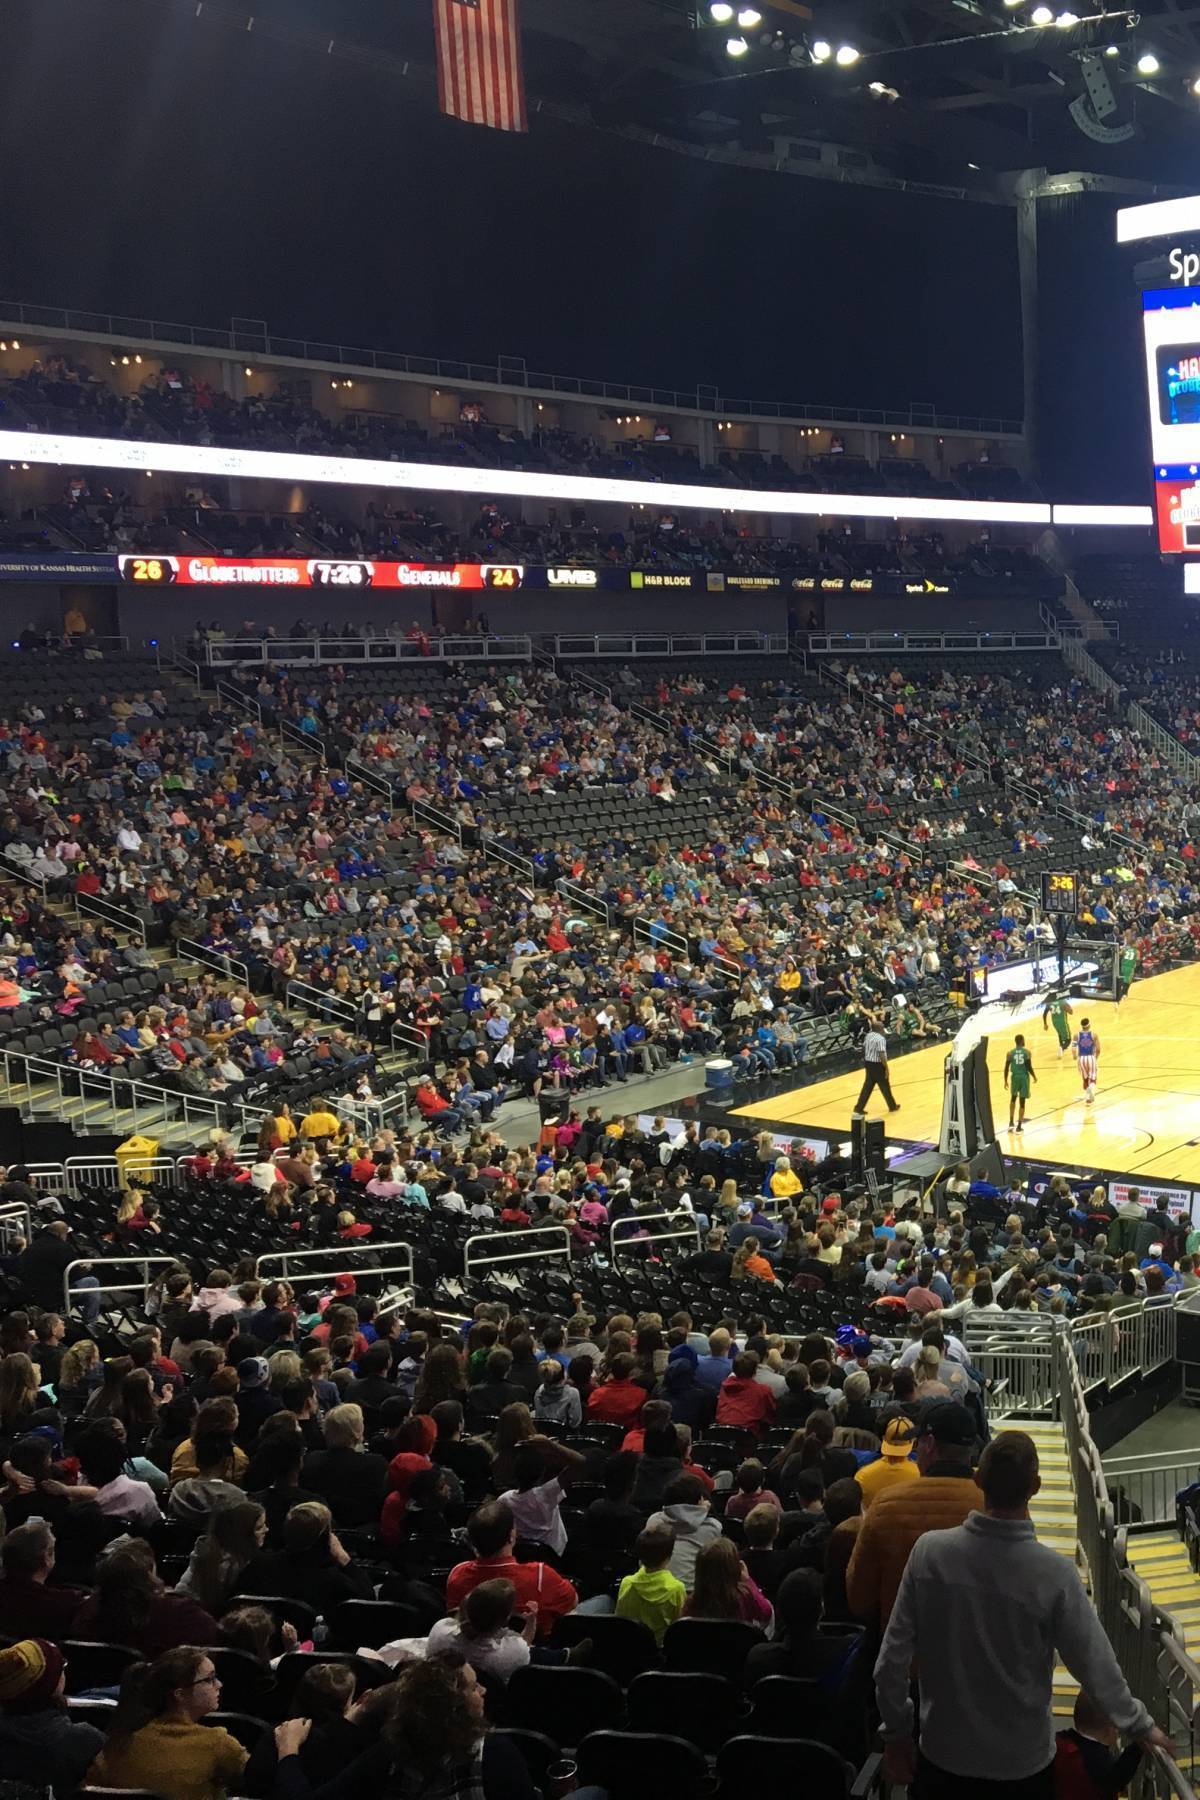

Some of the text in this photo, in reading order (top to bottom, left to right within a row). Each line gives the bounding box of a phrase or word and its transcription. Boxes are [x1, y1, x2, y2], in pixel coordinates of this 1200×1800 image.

[133, 560, 162, 580] 26
[317, 564, 363, 585] 7:26
[397, 564, 461, 586] GENERALS
[492, 569, 515, 586] 24
[547, 569, 597, 584] UMB
[664, 577, 692, 586] BLOCK
[1013, 1053, 1025, 1065] 15
